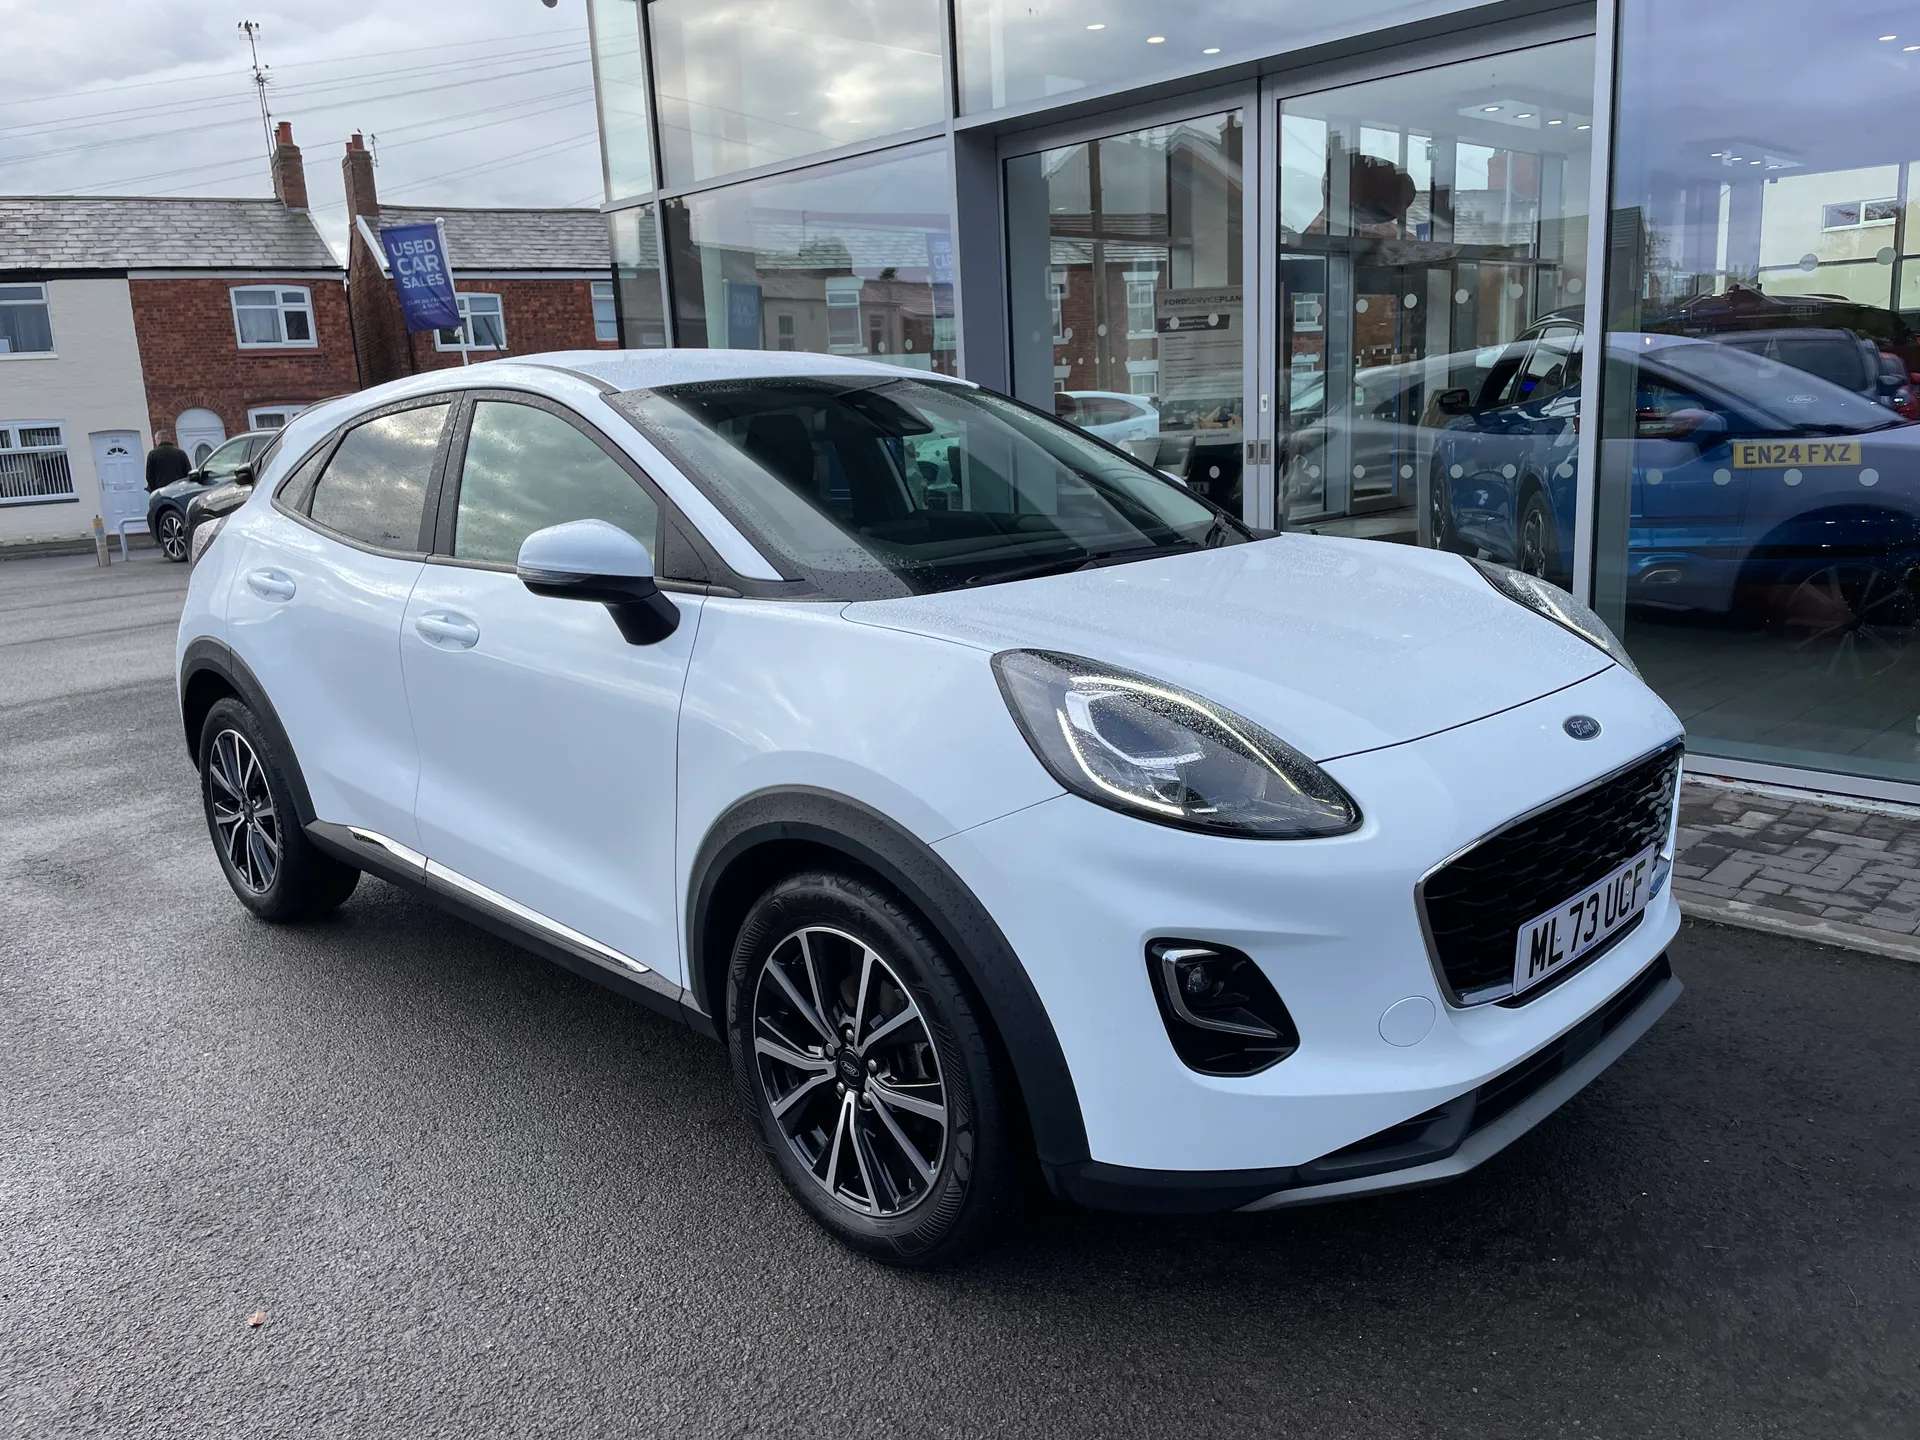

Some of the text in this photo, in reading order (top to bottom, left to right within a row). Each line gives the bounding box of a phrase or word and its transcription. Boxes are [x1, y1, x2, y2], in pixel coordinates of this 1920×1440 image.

[391, 239, 436, 256] USED
[397, 255, 440, 275] CAR
[402, 273, 445, 289] SALES
[1743, 444, 1851, 464] EN24 FXZ
